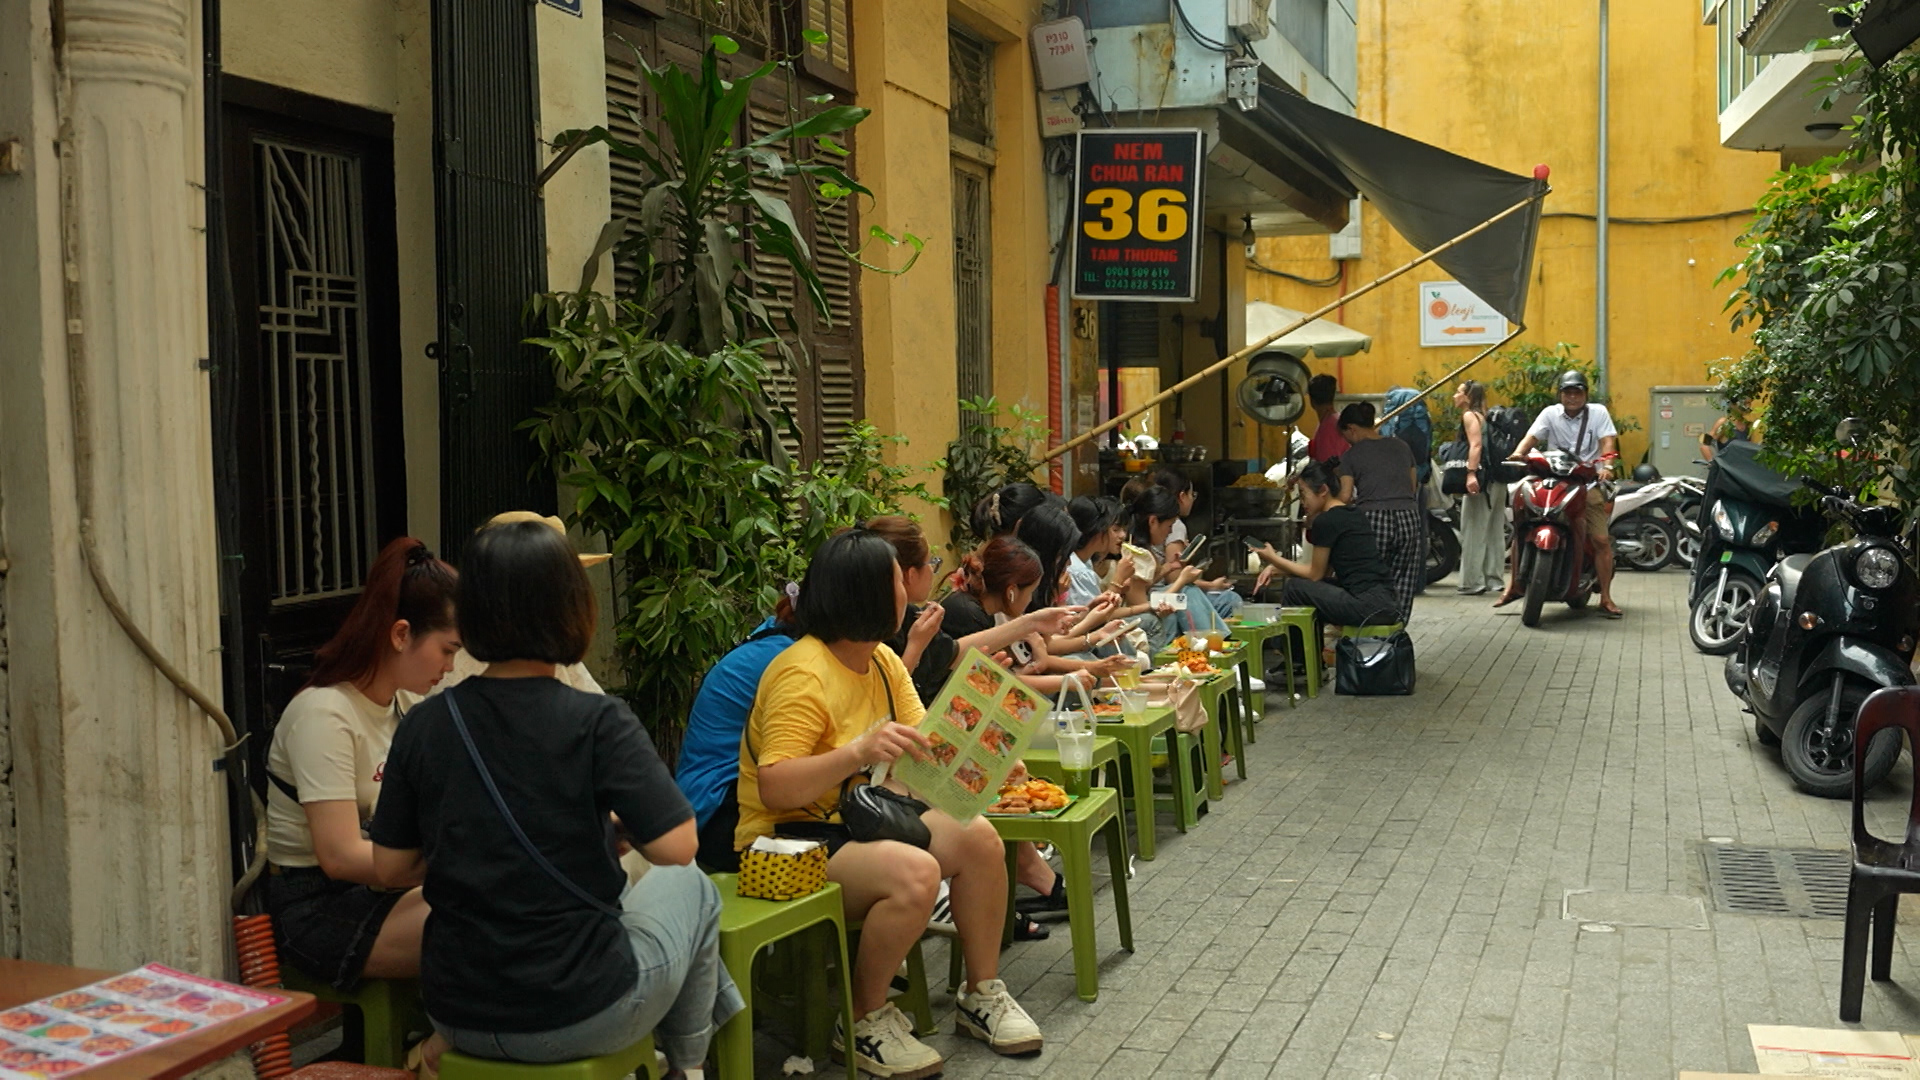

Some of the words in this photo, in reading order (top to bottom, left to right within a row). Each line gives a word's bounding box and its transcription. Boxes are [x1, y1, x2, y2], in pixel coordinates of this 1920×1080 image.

[1114, 142, 1163, 160] NEM
[1090, 164, 1139, 182] CHUA
[1083, 187, 1188, 242] 36
